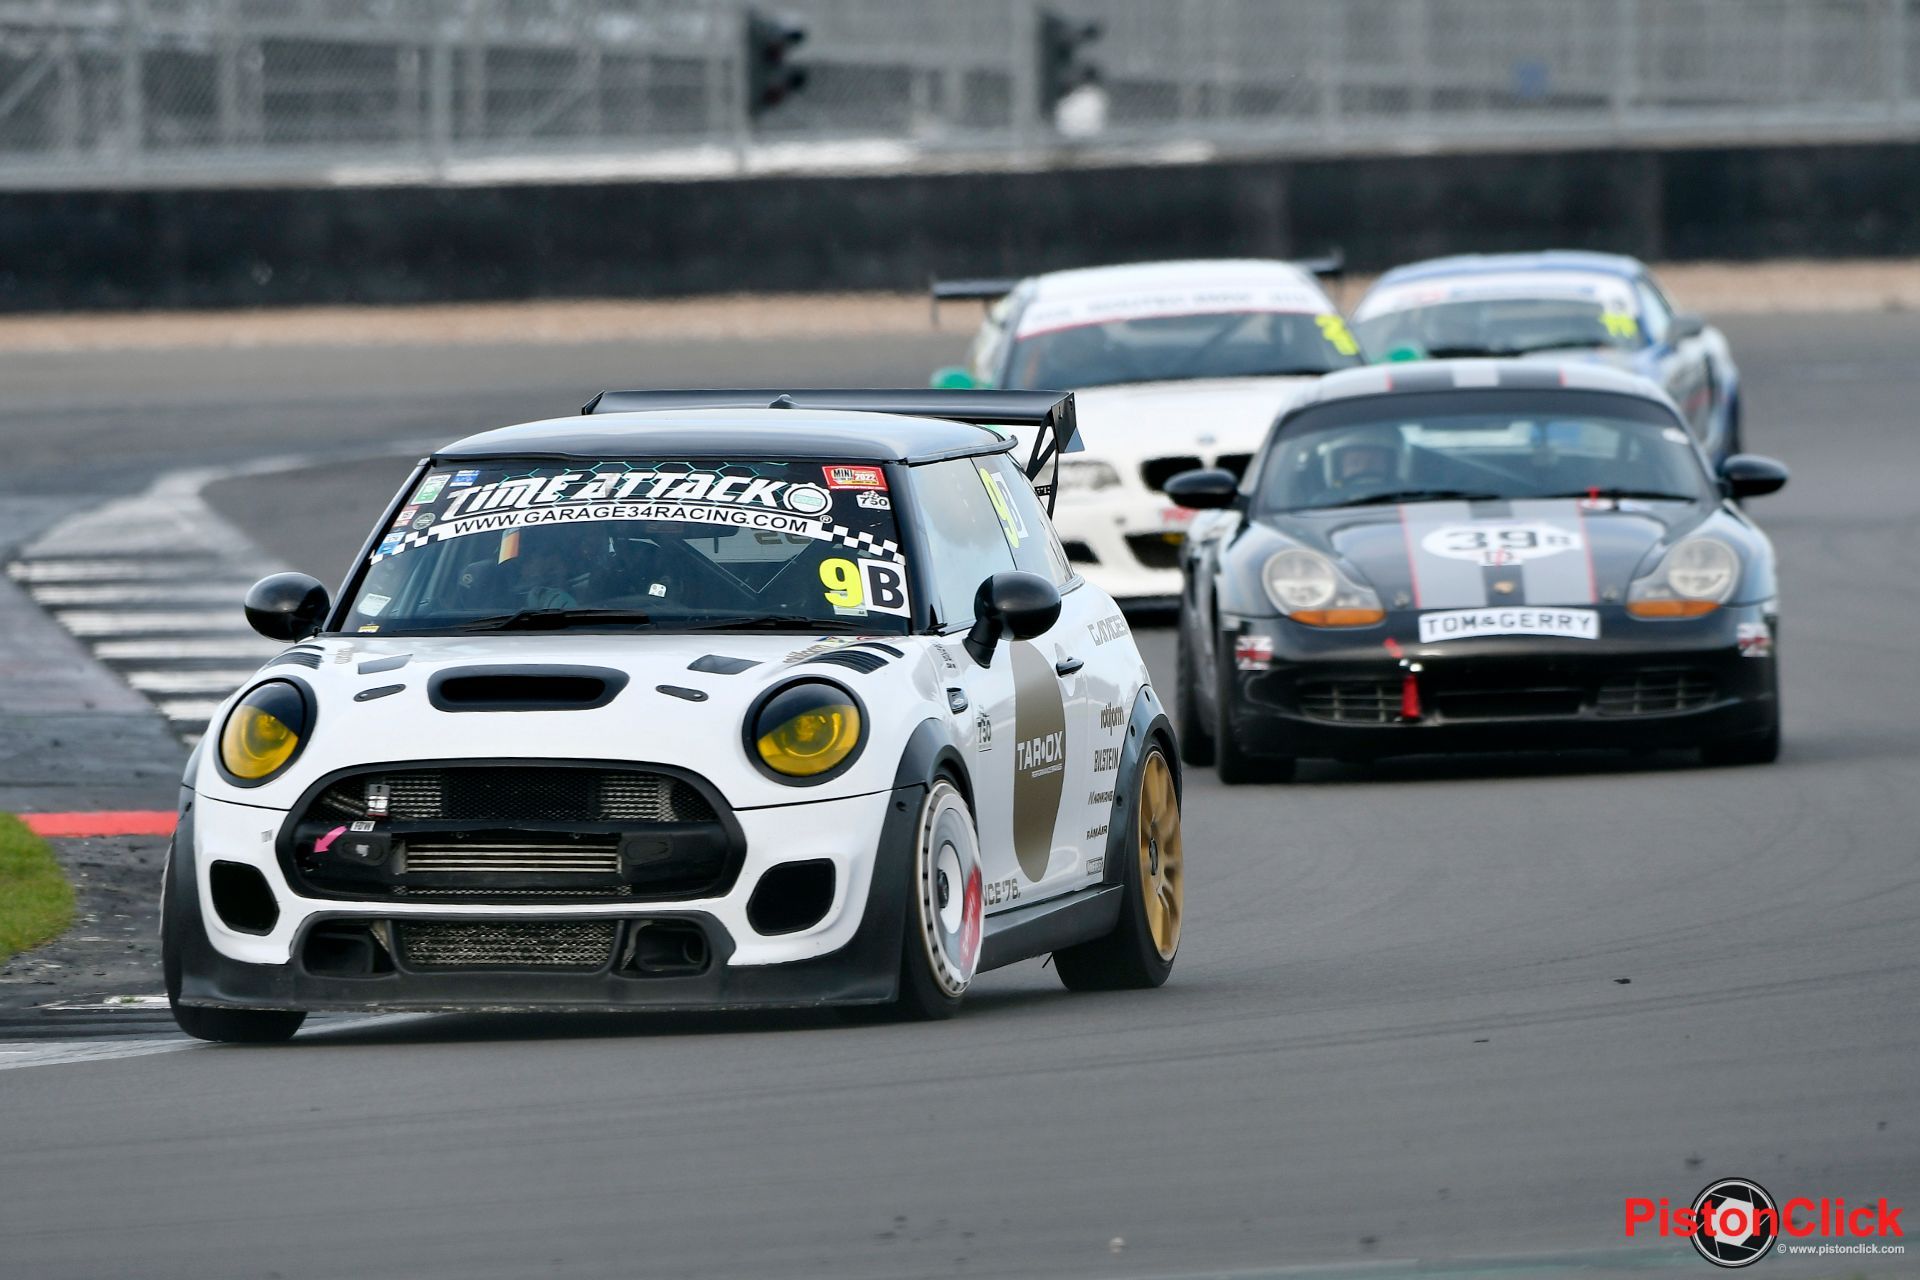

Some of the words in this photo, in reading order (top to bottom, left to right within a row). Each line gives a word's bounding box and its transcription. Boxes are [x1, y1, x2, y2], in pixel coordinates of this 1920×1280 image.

[833, 469, 853, 478] MINI
[854, 473, 876, 481] 2022
[569, 472, 788, 507] ATTACK
[860, 496, 888, 506] 750
[454, 506, 808, 534] WWW.GARAGE34RACING.COM
[980, 468, 1019, 548] 9
[1446, 531, 1537, 549] 39
[819, 557, 863, 608] 9
[868, 565, 904, 609] B
[1094, 747, 1119, 772] BILSTEIN
